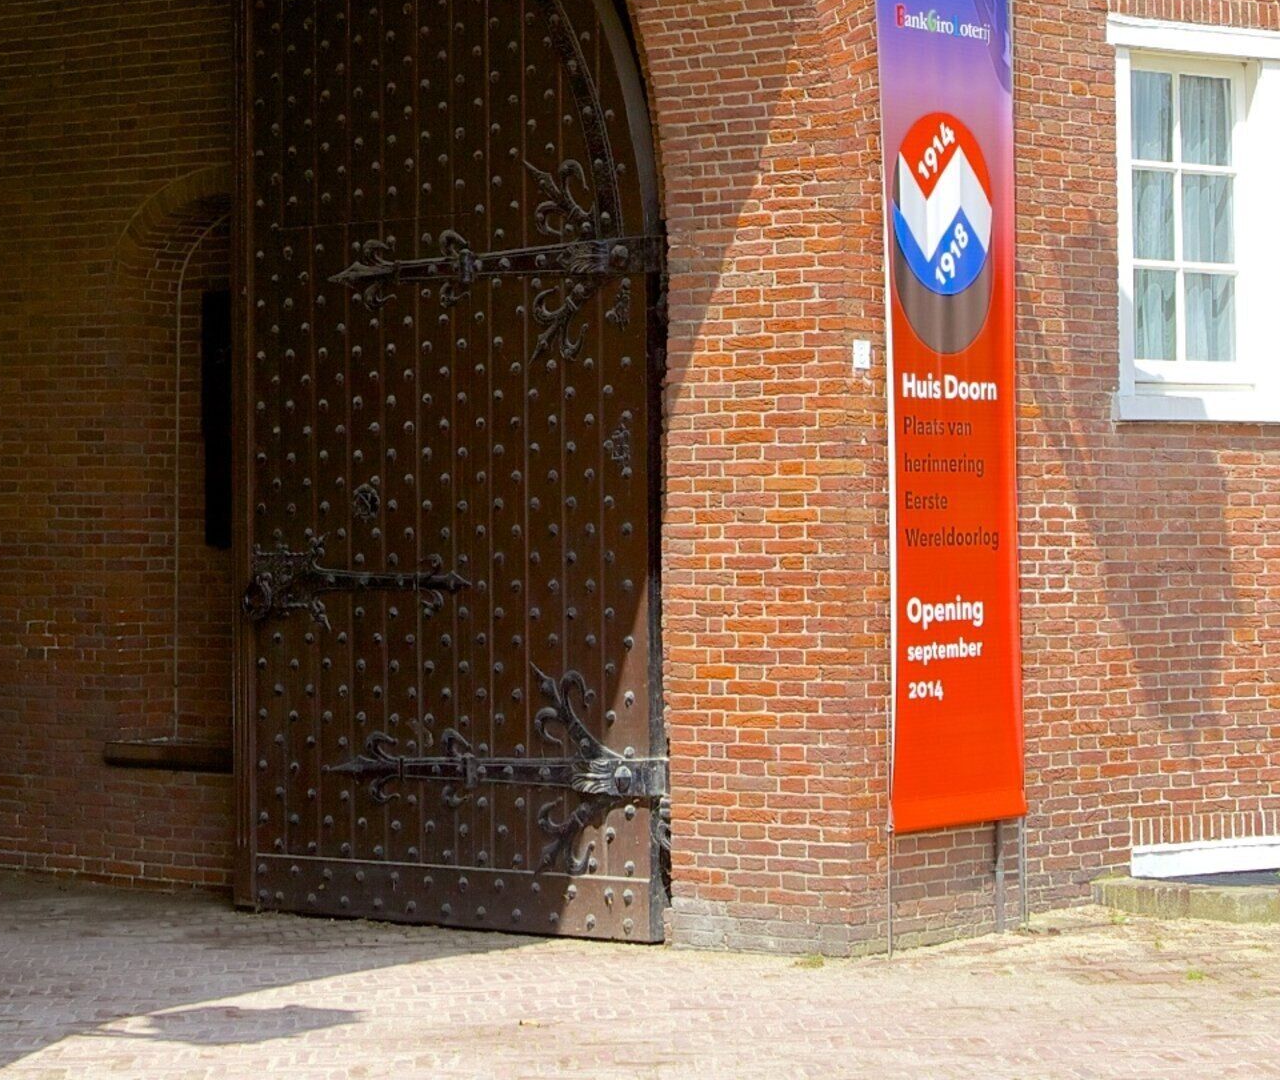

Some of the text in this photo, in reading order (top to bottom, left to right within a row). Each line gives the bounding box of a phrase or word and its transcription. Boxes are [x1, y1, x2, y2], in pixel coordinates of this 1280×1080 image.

[895, 3, 991, 47] BankGiroLoterij
[918, 122, 956, 180] 1914
[935, 222, 969, 286] 1918
[902, 372, 997, 400] Huis Doorn
[903, 416, 972, 436] Plaats van
[904, 453, 984, 478] herinnering
[905, 491, 948, 510] Eerste
[905, 526, 1000, 551] Wereldoorlog
[906, 594, 984, 630] Opening
[907, 636, 983, 665] september
[908, 680, 944, 701] 2014
